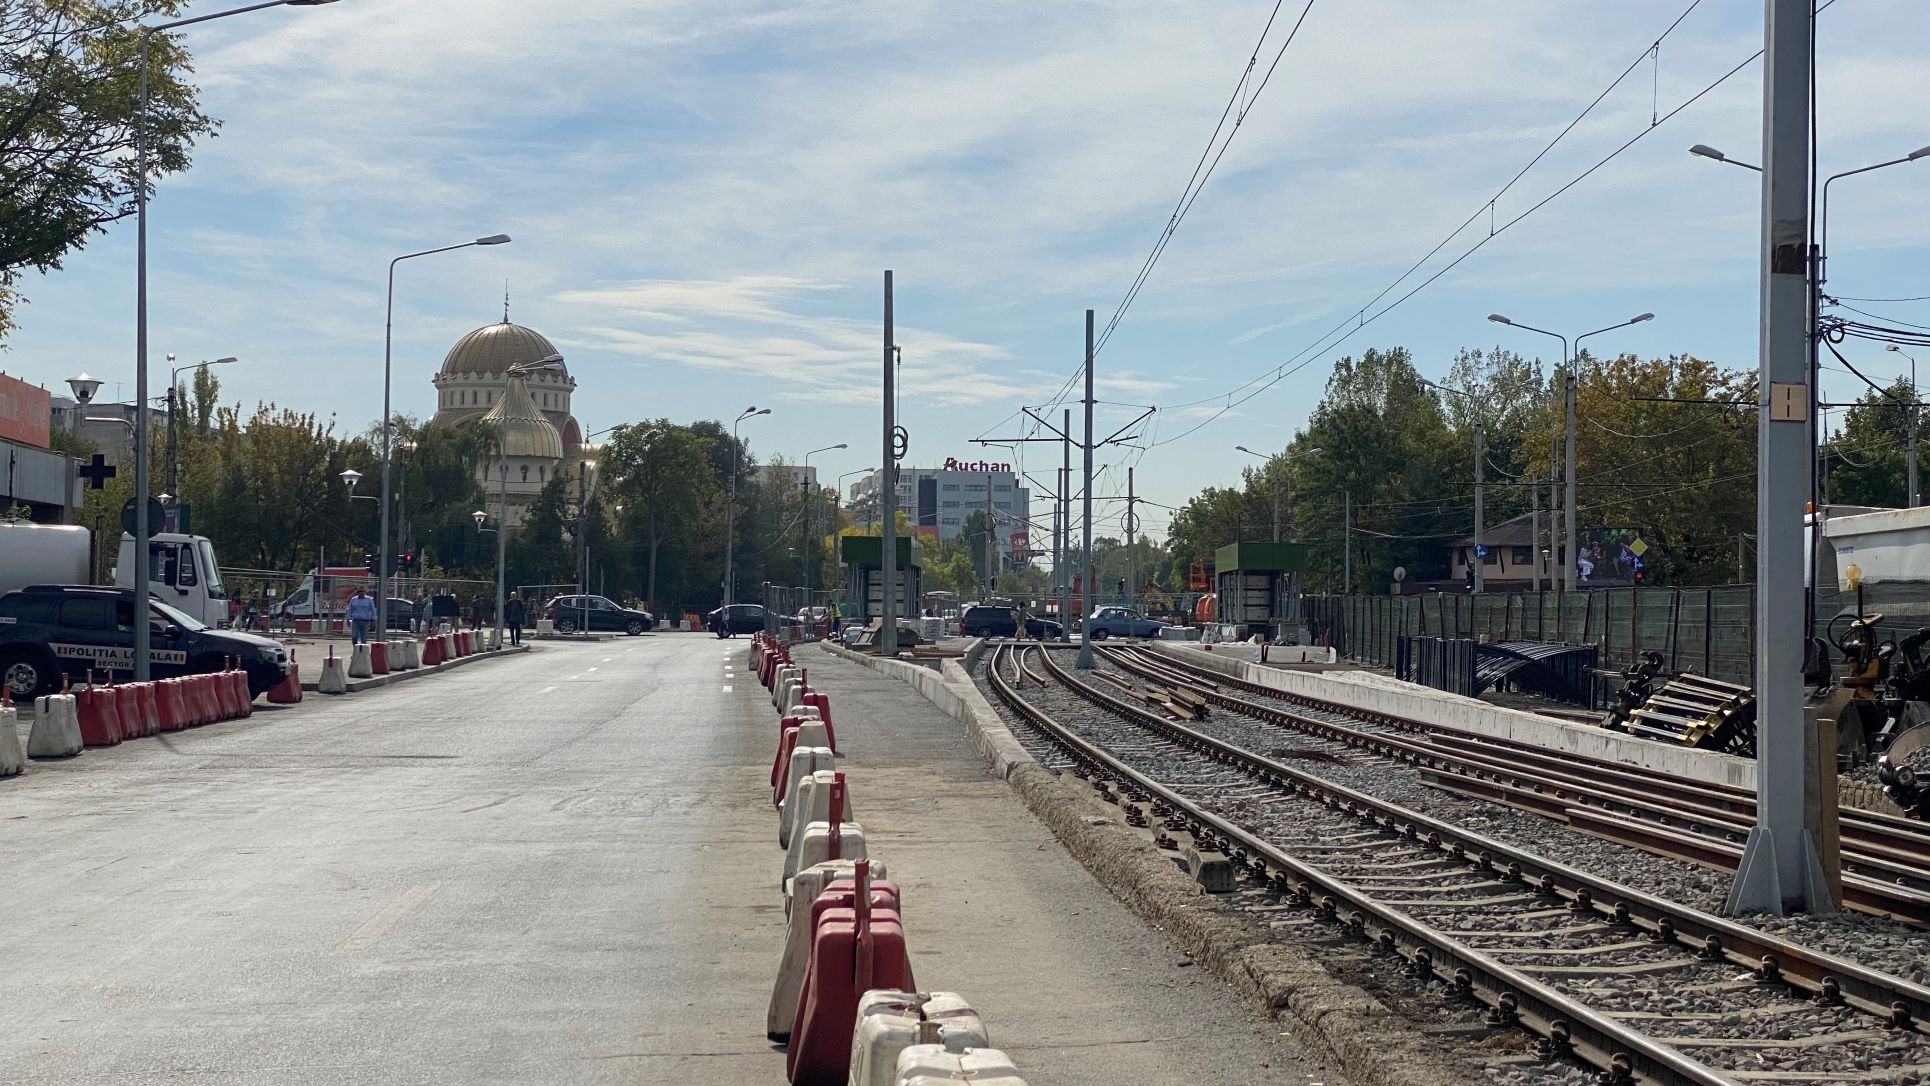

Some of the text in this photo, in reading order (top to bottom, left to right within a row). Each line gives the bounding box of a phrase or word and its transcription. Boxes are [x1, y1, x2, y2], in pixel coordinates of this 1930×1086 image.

[943, 457, 1011, 472] Auchan
[68, 647, 172, 662] POLITIA LOALA
[97, 660, 130, 668] SECTOR
